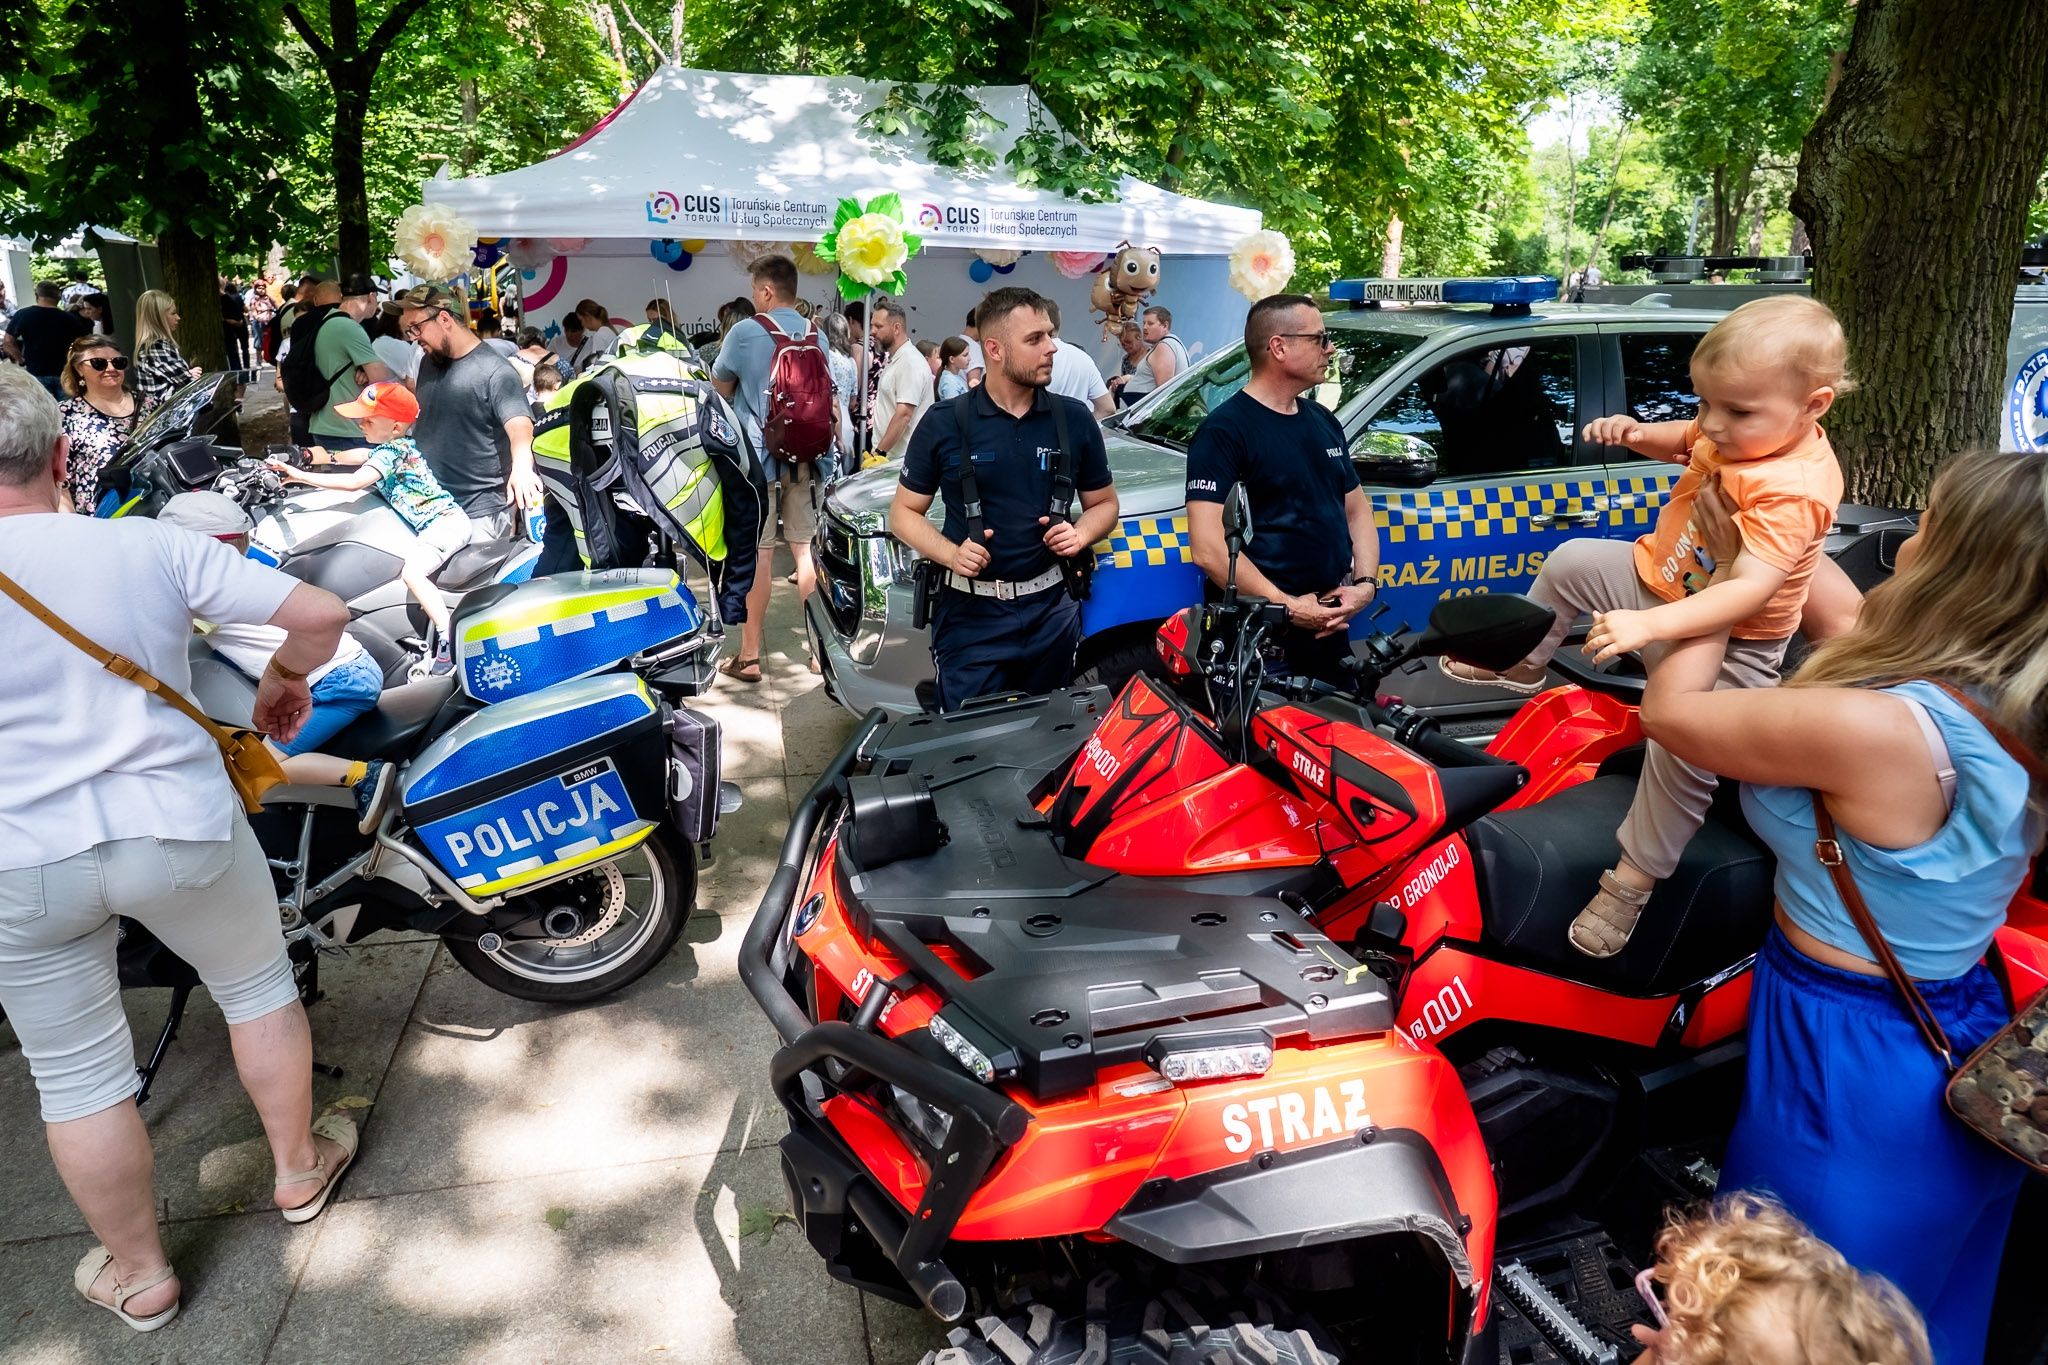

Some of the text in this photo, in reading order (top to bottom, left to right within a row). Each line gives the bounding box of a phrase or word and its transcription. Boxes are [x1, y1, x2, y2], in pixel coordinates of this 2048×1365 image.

[685, 195, 720, 213] CUS
[731, 198, 827, 213] Toruńskie Centrum
[685, 213, 720, 223] TORUŃ
[731, 212, 827, 229] Usług Społecznych
[946, 207, 980, 224] CUS
[990, 208, 1077, 222] Toruńskie Centrum
[946, 223, 979, 233] TORUŃ
[989, 222, 1077, 238] Usług Społecznych
[1397, 284, 1440, 300] MIEJSKA
[680, 316, 721, 335] ruńsk
[2015, 352, 2048, 395] PATR
[642, 433, 678, 461] POLICJA
[1187, 479, 1217, 492] POLICJA
[1662, 556, 1679, 583] GO
[1675, 532, 1692, 559] ON
[1377, 551, 1548, 589] RAŻ MIEJS
[573, 765, 599, 783] BMW
[445, 782, 621, 867] POLICJA
[1403, 843, 1460, 907] GRONOWO
